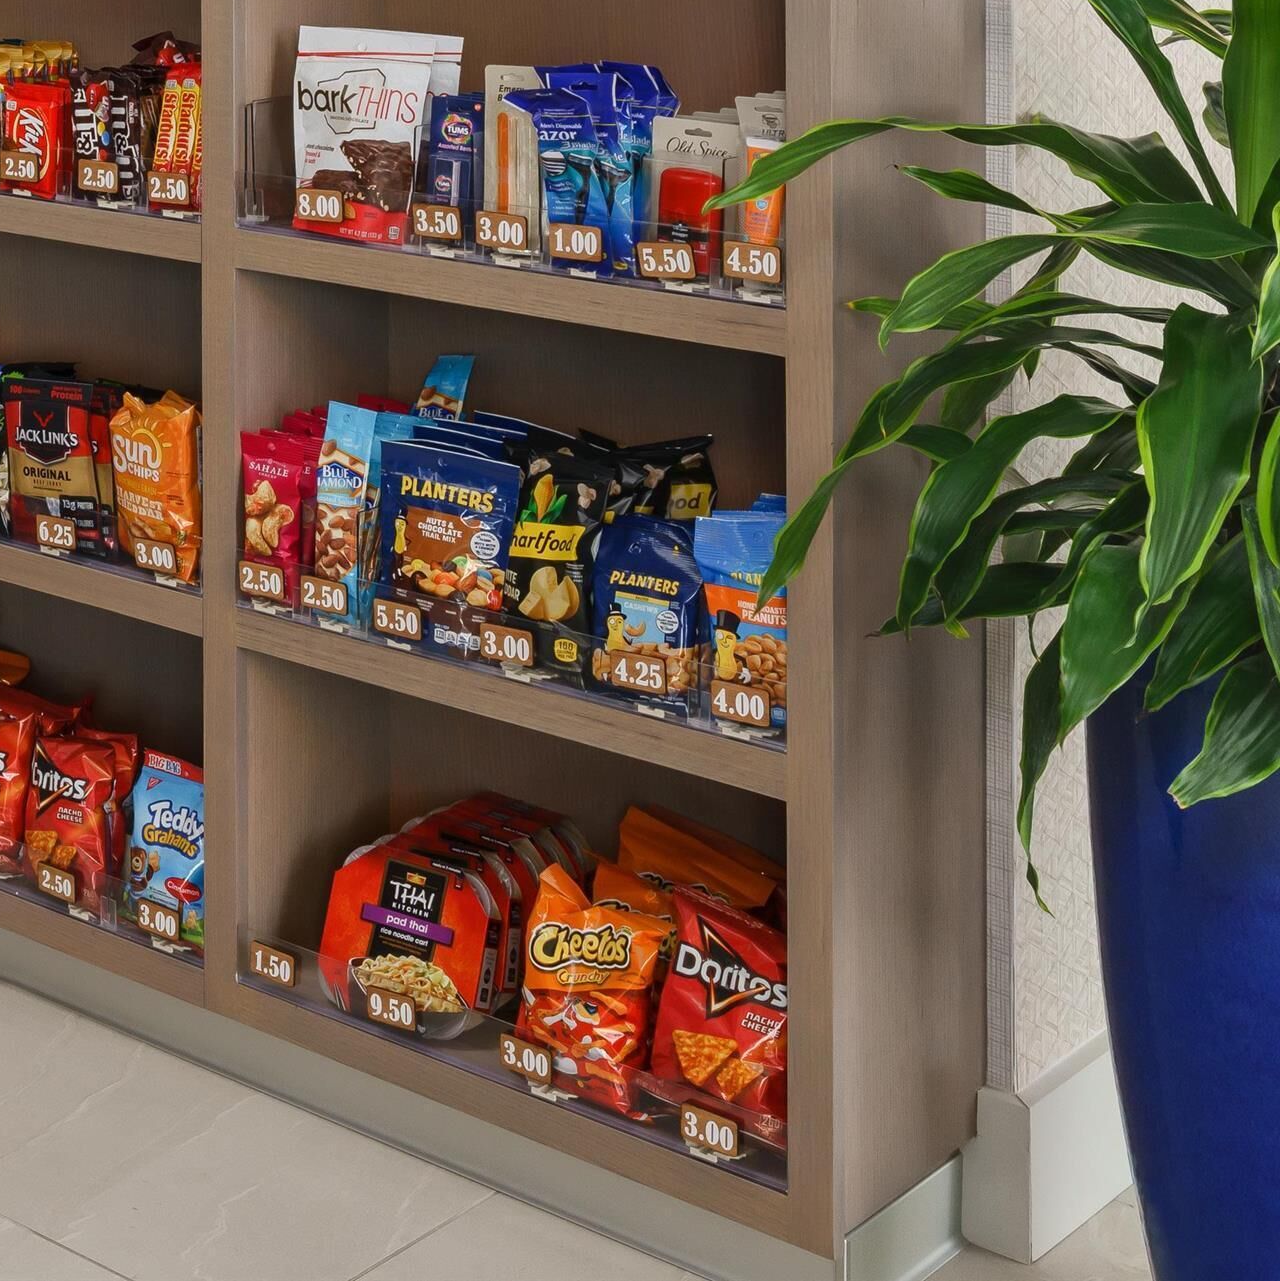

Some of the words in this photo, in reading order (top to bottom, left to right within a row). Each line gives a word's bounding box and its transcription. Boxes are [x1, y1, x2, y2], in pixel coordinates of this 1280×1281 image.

[445, 124, 470, 136] TUMS
[666, 136, 692, 154] Old
[695, 141, 729, 159] Spice
[5, 157, 35, 179] 2.50
[83, 167, 115, 189] 2.50
[150, 176, 187, 200] 2.50
[297, 192, 340, 219] 8.00
[415, 209, 458, 236] 3.50
[479, 217, 524, 246] 3.00
[554, 228, 597, 256] 1.00
[642, 247, 691, 273] 5.50
[727, 246, 777, 277] 4.50
[15, 426, 40, 445] JACK
[42, 428, 79, 448] LINK'S
[23, 466, 72, 482] ORIGINAL
[126, 463, 161, 483] CHIPS
[248, 460, 289, 479] SAHALE
[400, 474, 495, 514] PLANTERS
[39, 521, 74, 547] 6.25
[136, 542, 173, 569] 3.00
[242, 566, 282, 595] 2.50
[609, 570, 680, 597] PLANTERS
[303, 581, 345, 611] 2.50
[376, 605, 419, 635] 5.50
[484, 629, 530, 662] 3.00
[614, 660, 663, 690] 4.25
[713, 687, 765, 721] 4.00
[148, 801, 204, 841] Teddy
[142, 824, 199, 860] Grahams
[41, 869, 72, 898] 2.50
[389, 879, 436, 911] THAI
[139, 906, 177, 937] 3.00
[385, 913, 409, 928] pad
[409, 918, 429, 934] thai
[391, 901, 430, 919] KITCHEN
[532, 923, 632, 969] Cheetos
[254, 949, 292, 983] 1.50
[556, 969, 610, 985] Crunchy
[675, 942, 787, 1010] Doritos
[369, 992, 413, 1026] 9.50
[503, 1039, 549, 1078] 3.00
[683, 1111, 735, 1152] 3.00
